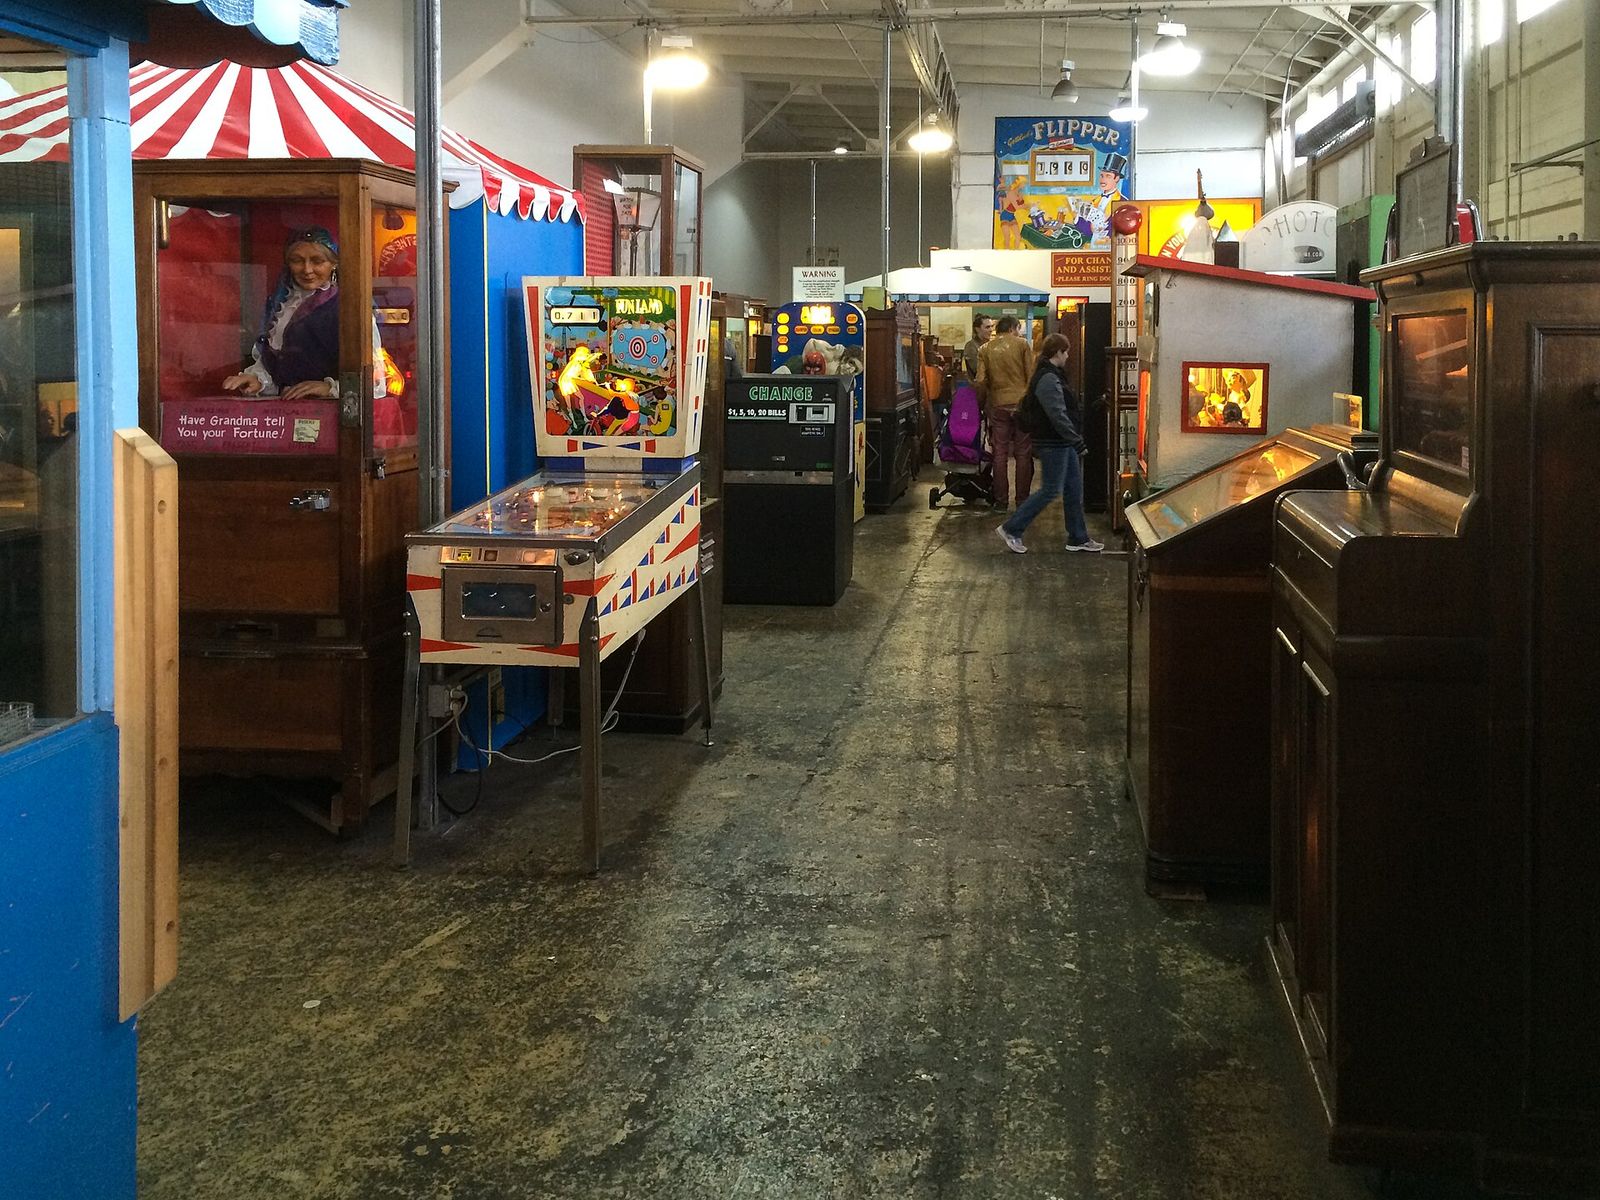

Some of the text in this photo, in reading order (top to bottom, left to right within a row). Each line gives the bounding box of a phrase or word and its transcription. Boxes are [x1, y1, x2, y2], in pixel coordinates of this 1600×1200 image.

[1032, 119, 1120, 146] FLIPPER
[1065, 256, 1084, 265] FOR
[801, 270, 837, 278] WARNING
[1056, 265, 1077, 274] AND
[1117, 277, 1136, 285] 800
[1118, 298, 1136, 306] 700
[1117, 319, 1136, 327] 600
[748, 385, 813, 401] CHANGE
[728, 407, 738, 417] $1,
[747, 408, 757, 417] 10,
[758, 408, 767, 416] 20
[179, 415, 206, 426] Have
[209, 415, 259, 426] Grandma
[264, 416, 285, 426] tell
[177, 427, 285, 440] You your Fortune!
